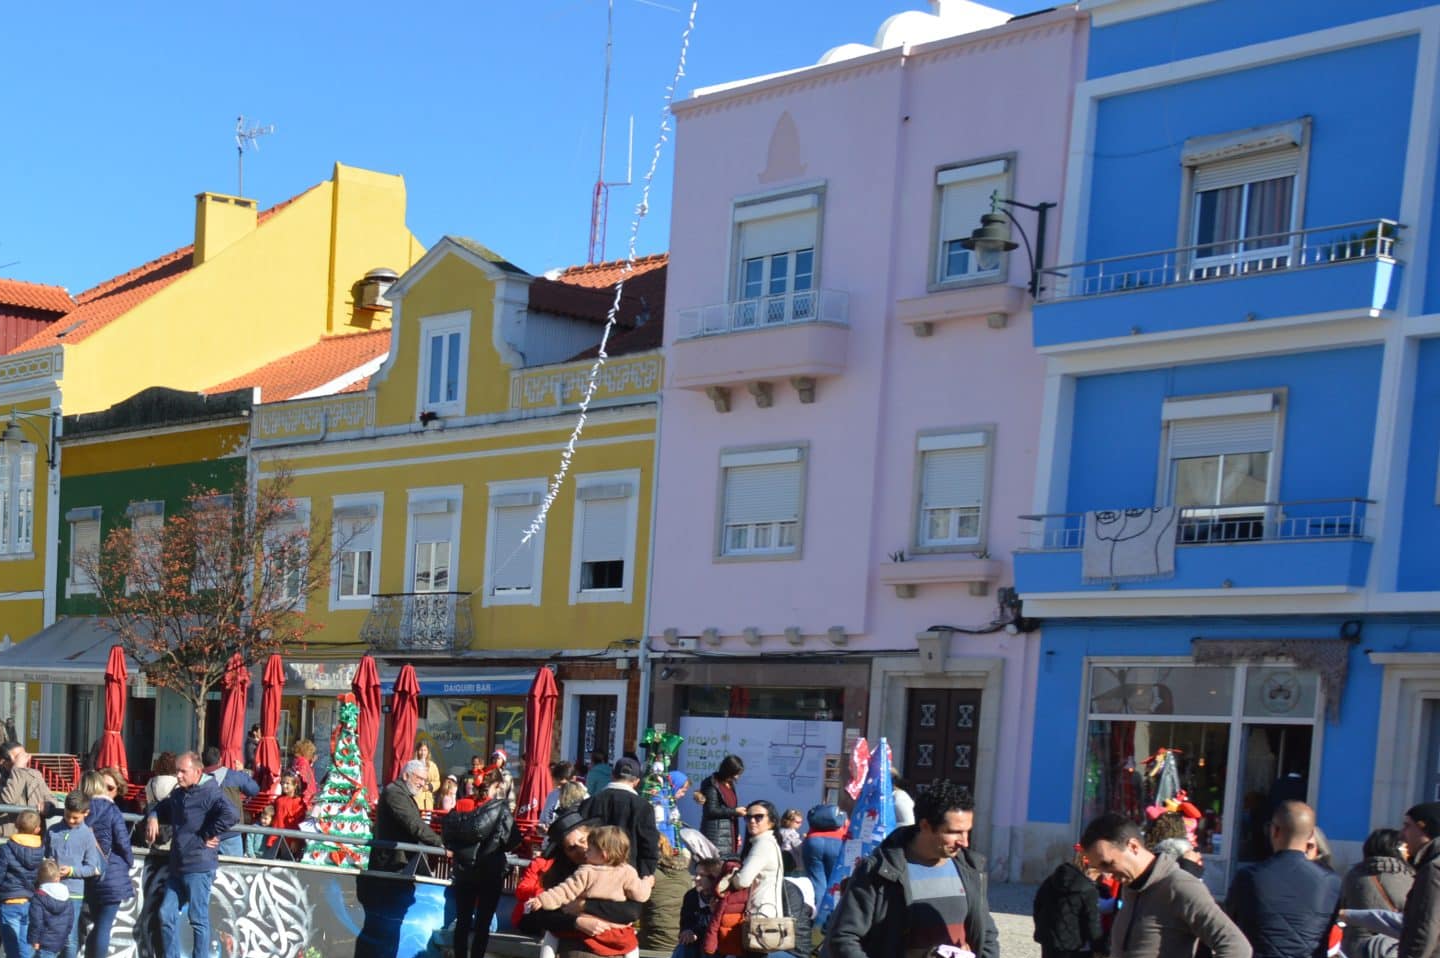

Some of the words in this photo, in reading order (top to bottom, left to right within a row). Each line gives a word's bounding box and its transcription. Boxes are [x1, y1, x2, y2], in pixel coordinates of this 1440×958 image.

[443, 683, 474, 693] DAIQUIRI
[475, 683, 492, 692] BAR
[687, 735, 718, 746] NOVO
[686, 760, 720, 770] MESM
